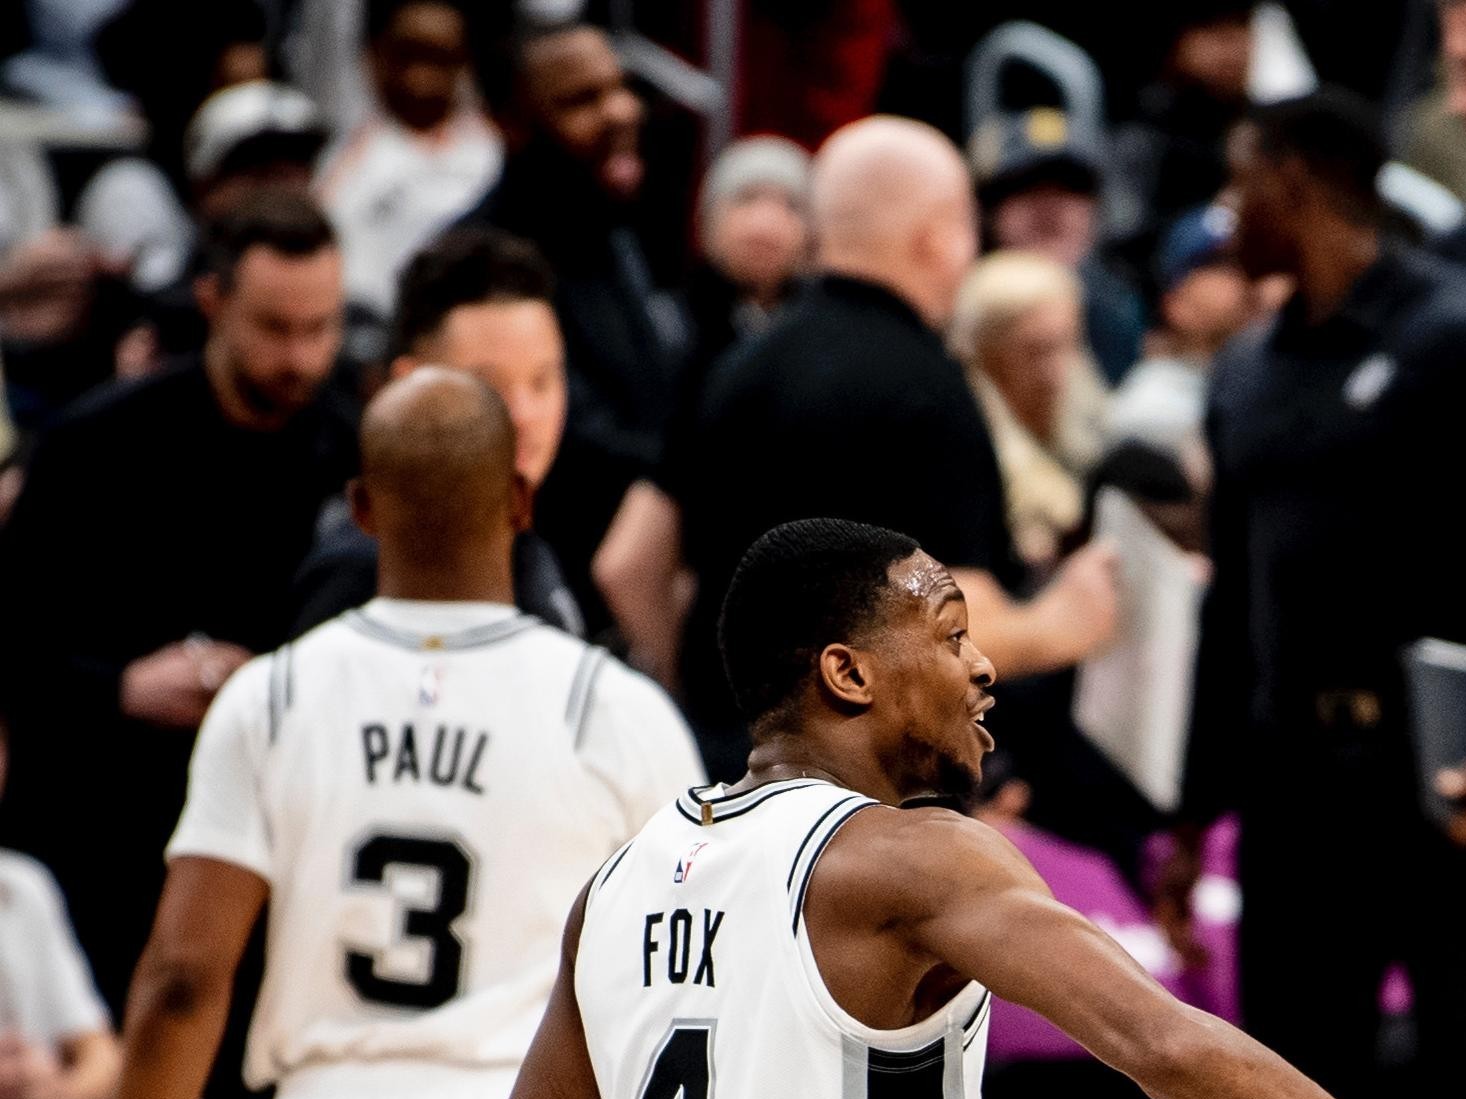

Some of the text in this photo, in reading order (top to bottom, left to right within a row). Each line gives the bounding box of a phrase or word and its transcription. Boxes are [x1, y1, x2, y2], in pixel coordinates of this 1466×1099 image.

[361, 722, 489, 796] PAUL
[343, 826, 479, 1012] 3
[643, 907, 725, 988] FOX
